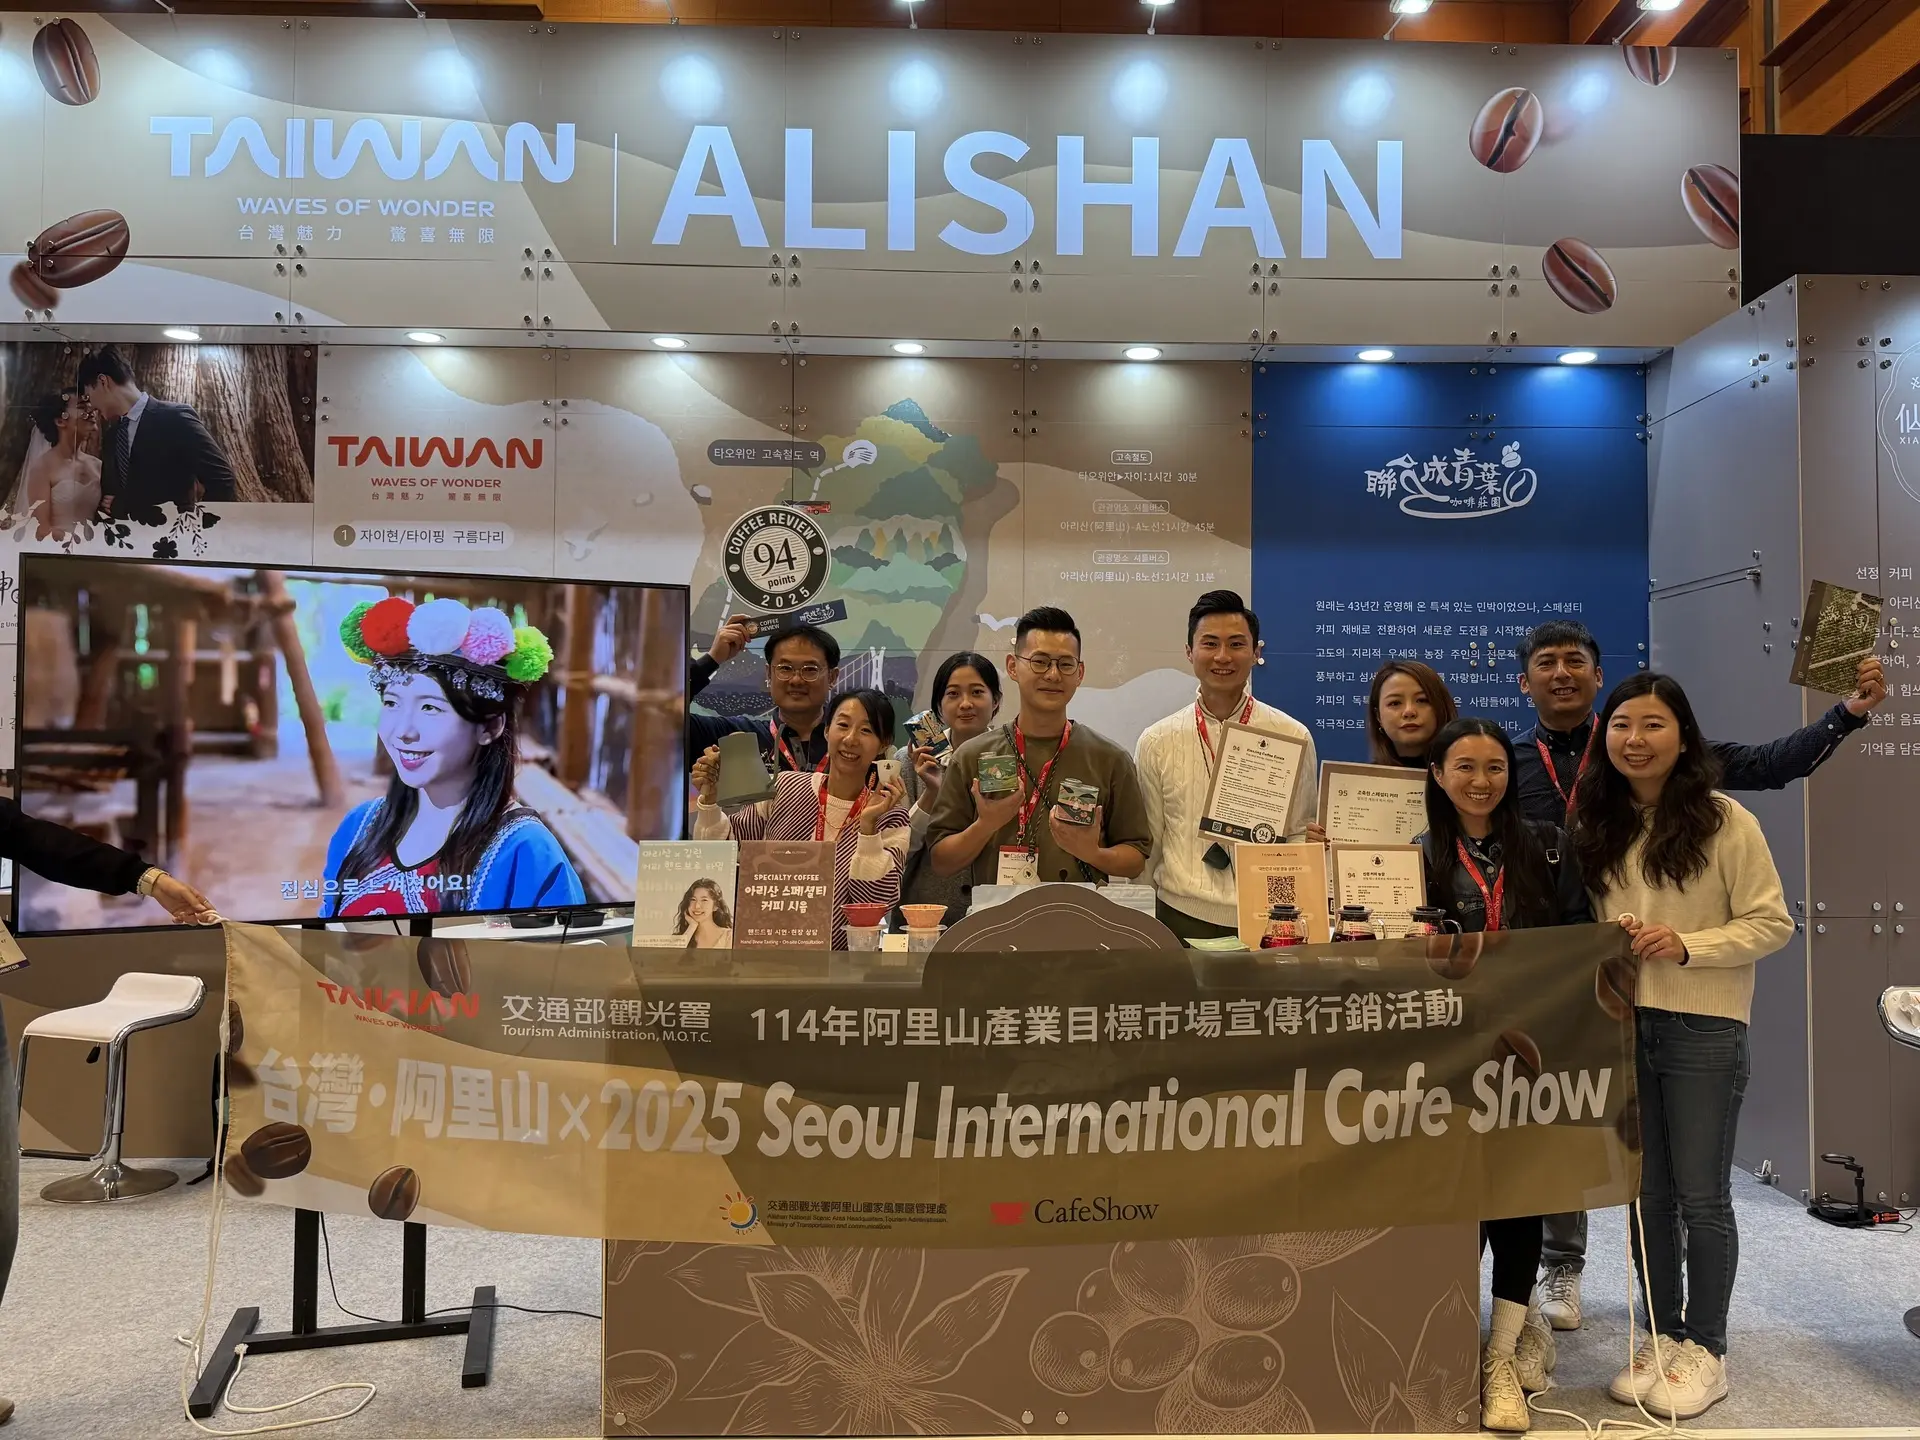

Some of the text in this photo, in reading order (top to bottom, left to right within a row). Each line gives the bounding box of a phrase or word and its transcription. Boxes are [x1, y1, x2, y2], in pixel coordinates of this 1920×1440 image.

[150, 116, 575, 183] TAIWAN
[652, 125, 1402, 259] ALISHAN
[237, 196, 495, 218] WAVES OF WONDER
[238, 224, 495, 244] 台灣魅力 驚喜無限
[328, 435, 543, 469] TAIWAN
[714, 447, 820, 461] 타오위안 고속철도 역
[1115, 453, 1149, 462] 고속철도
[371, 477, 502, 488] WAVES OF WONDER
[1177, 472, 1198, 483] 30분
[728, 512, 817, 555] COFFEE REVIEW
[1194, 521, 1216, 533] 45분
[341, 529, 504, 545] 1 자이현/타이핑 구름다리
[753, 537, 797, 577] 94
[1195, 571, 1216, 583] 11분
[1856, 566, 1912, 580] 선정 커피
[767, 575, 796, 589] points
[761, 585, 810, 608] 2025
[1315, 600, 1582, 614] 원래는 43년간 운영해 온 특색 있는 민박이었으나, 스페셜티
[759, 618, 779, 627] COFFEE
[760, 624, 780, 632] REVIEW
[1315, 624, 1335, 635] 커피
[1341, 624, 1371, 635] 재배로
[1377, 625, 1417, 636] 전환하여
[1422, 625, 1453, 636] 새로운
[1459, 625, 1488, 637] 도전을
[1315, 648, 1345, 659] 고도의
[1352, 648, 1381, 659] 지리적
[1388, 648, 1418, 660] 우세와
[1424, 649, 1444, 660] 농장
[1451, 649, 1480, 660] 주인의
[1315, 671, 1355, 682] 풍부하고
[1449, 672, 1503, 684] 자랑합니다.
[1315, 695, 1345, 706] 커피의
[1469, 696, 1520, 708] 사람들에게
[1315, 719, 1365, 730] 적극적으로
[1860, 742, 1896, 756] 기억을
[1338, 789, 1348, 797] 95
[280, 878, 359, 901] 진심으로
[744, 885, 827, 899] 아리산 스페셜티
[761, 900, 808, 914] 커피 시음
[316, 981, 480, 1019] TAIWAN
[501, 994, 712, 1030] 交通部觀光署
[750, 988, 1463, 1047] 114年阿里山產業目標市場宣傳行銷活動
[354, 1013, 385, 1026] WAVES
[501, 1023, 712, 1044] Tourism Administration, M.O.T.C.
[756, 1080, 919, 1160] Seoul
[934, 1067, 1307, 1160] International
[1324, 1061, 1453, 1146] Cafe
[1467, 1054, 1612, 1134] Show
[1034, 1196, 1160, 1225] CafeShow
[789, 1221, 796, 1229] of
